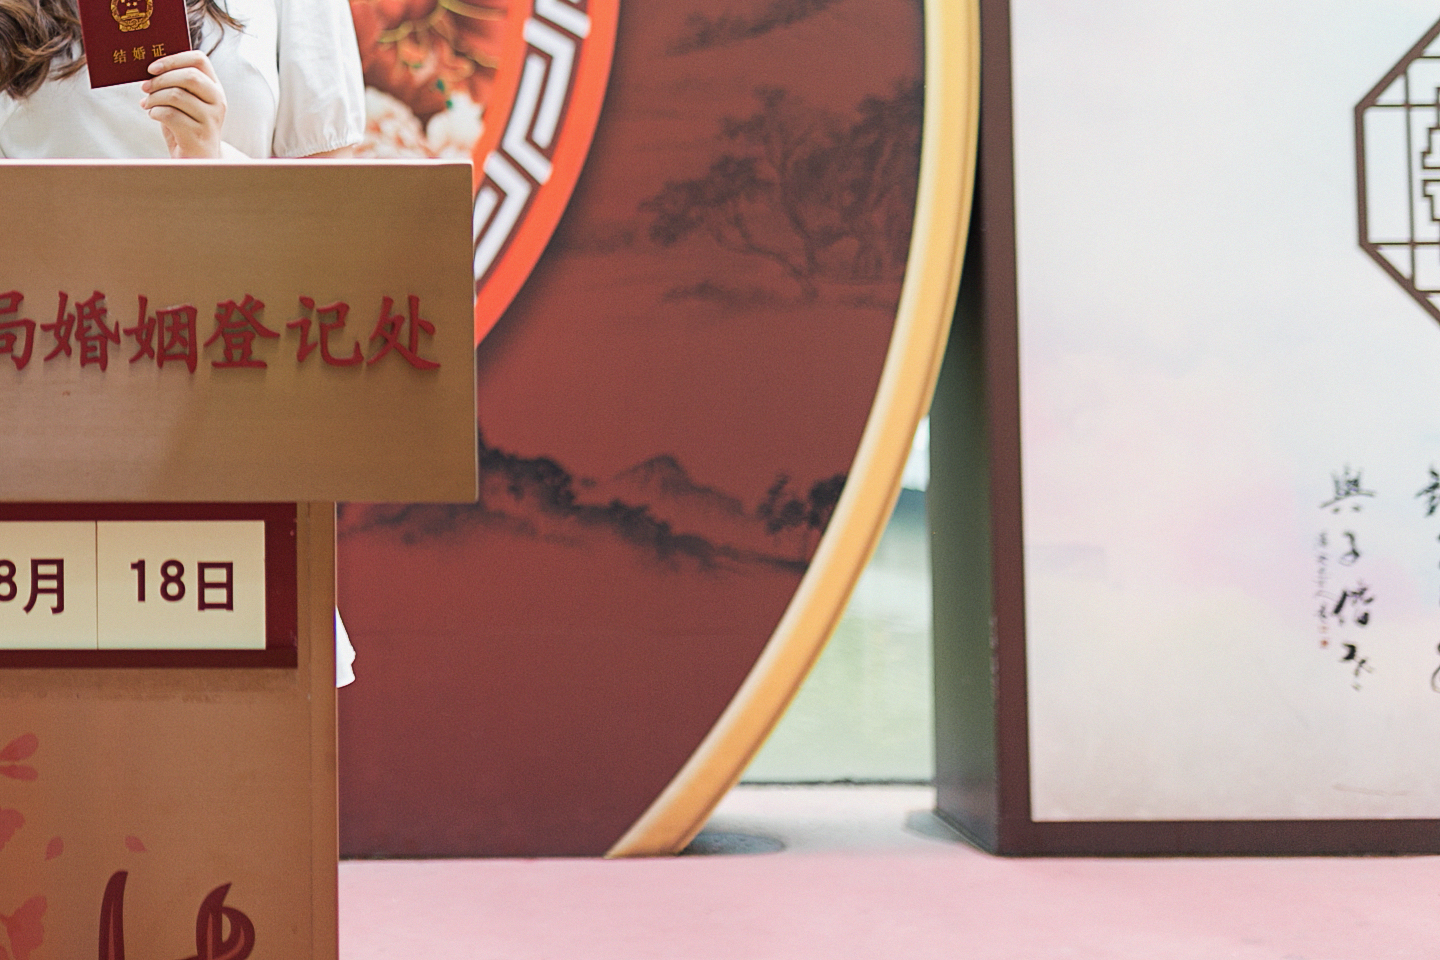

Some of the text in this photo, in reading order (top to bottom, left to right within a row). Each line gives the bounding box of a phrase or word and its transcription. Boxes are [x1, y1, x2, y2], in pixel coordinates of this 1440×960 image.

[112, 43, 167, 64] 结婚证
[130, 558, 235, 612] 18日
